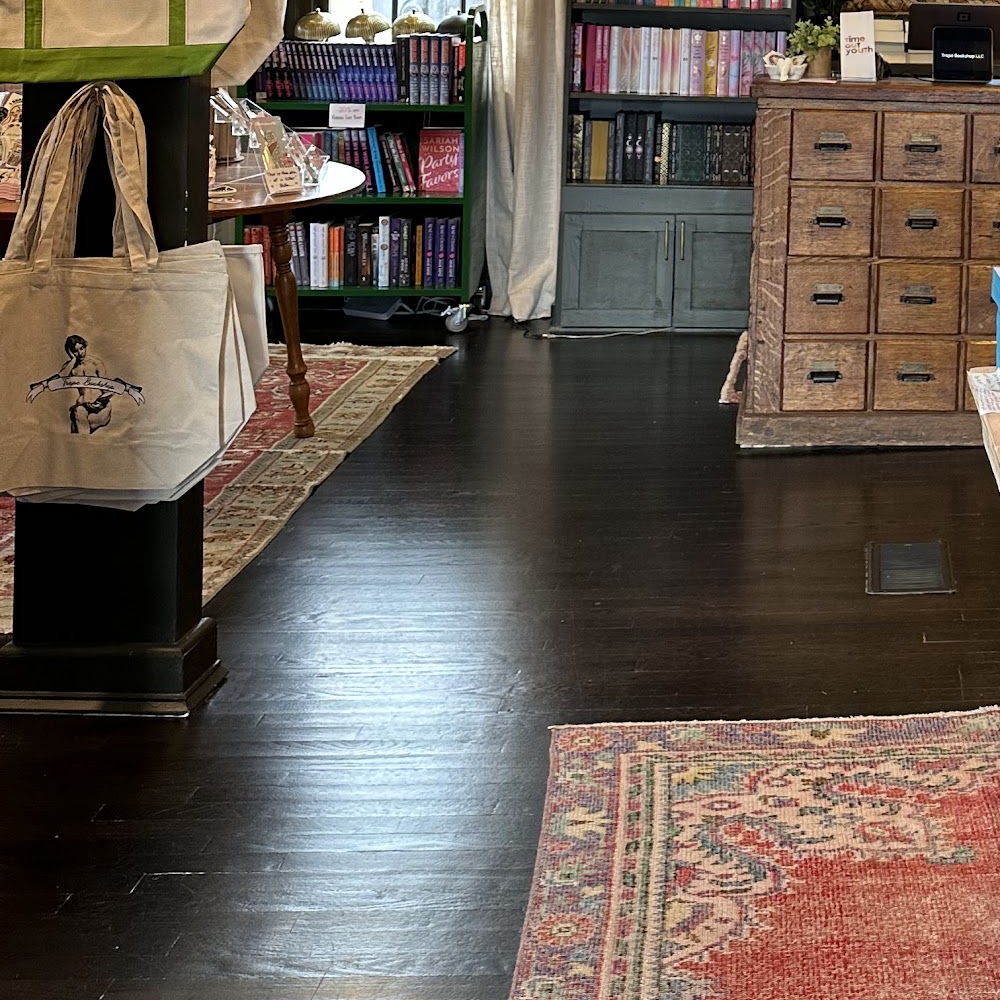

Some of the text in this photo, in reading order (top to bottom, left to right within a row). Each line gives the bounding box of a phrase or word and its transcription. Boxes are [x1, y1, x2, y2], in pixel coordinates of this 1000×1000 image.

[421, 144, 459, 153] WILSON
[424, 137, 459, 145] SARIAH
[420, 153, 459, 174] Party
[420, 168, 459, 189] Favors
